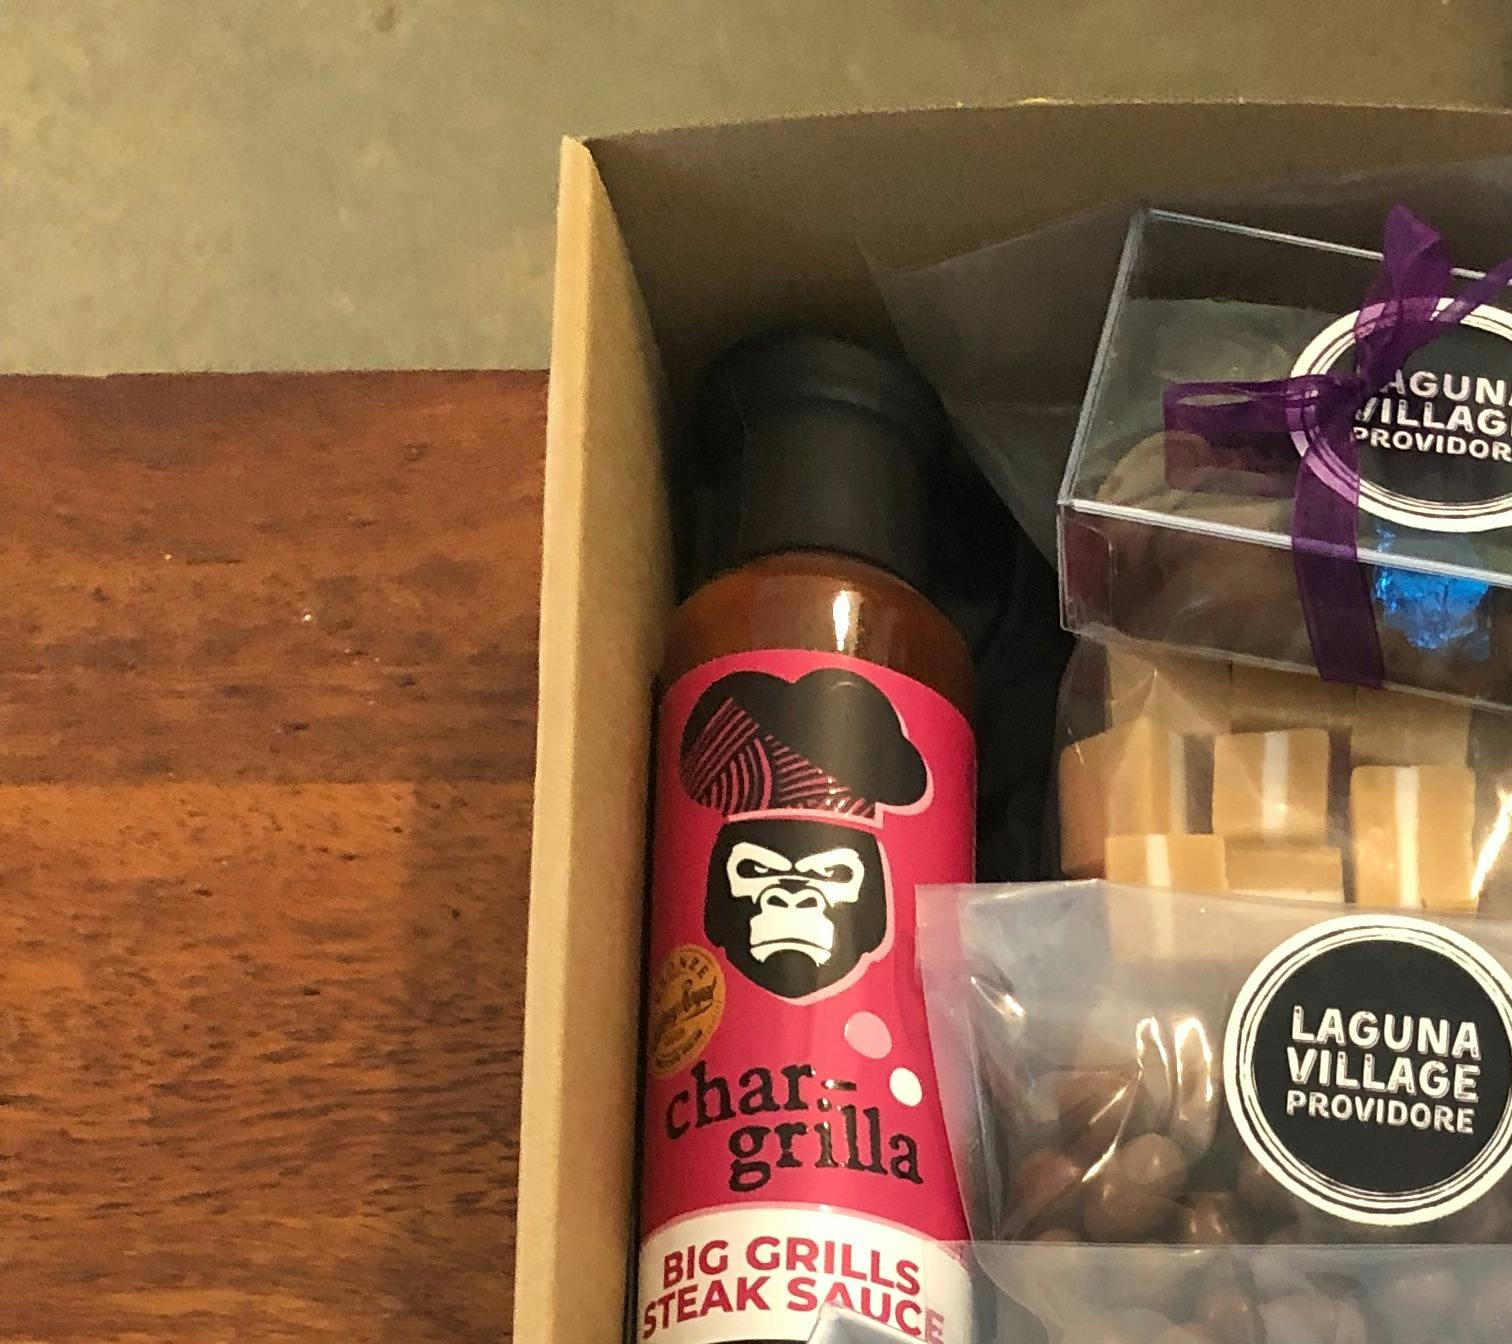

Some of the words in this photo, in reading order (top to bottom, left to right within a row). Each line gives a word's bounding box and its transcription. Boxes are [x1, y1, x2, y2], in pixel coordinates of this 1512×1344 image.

[1290, 1005, 1482, 1060] LAGUNA
[1286, 1046, 1482, 1104] VILLAGE
[1286, 1089, 1476, 1135] PROVIDORE
[727, 1097, 924, 1193] grilla
[662, 1239, 730, 1290] BIG
[745, 1235, 921, 1297] GRILLS
[641, 1275, 771, 1341] STEAK
